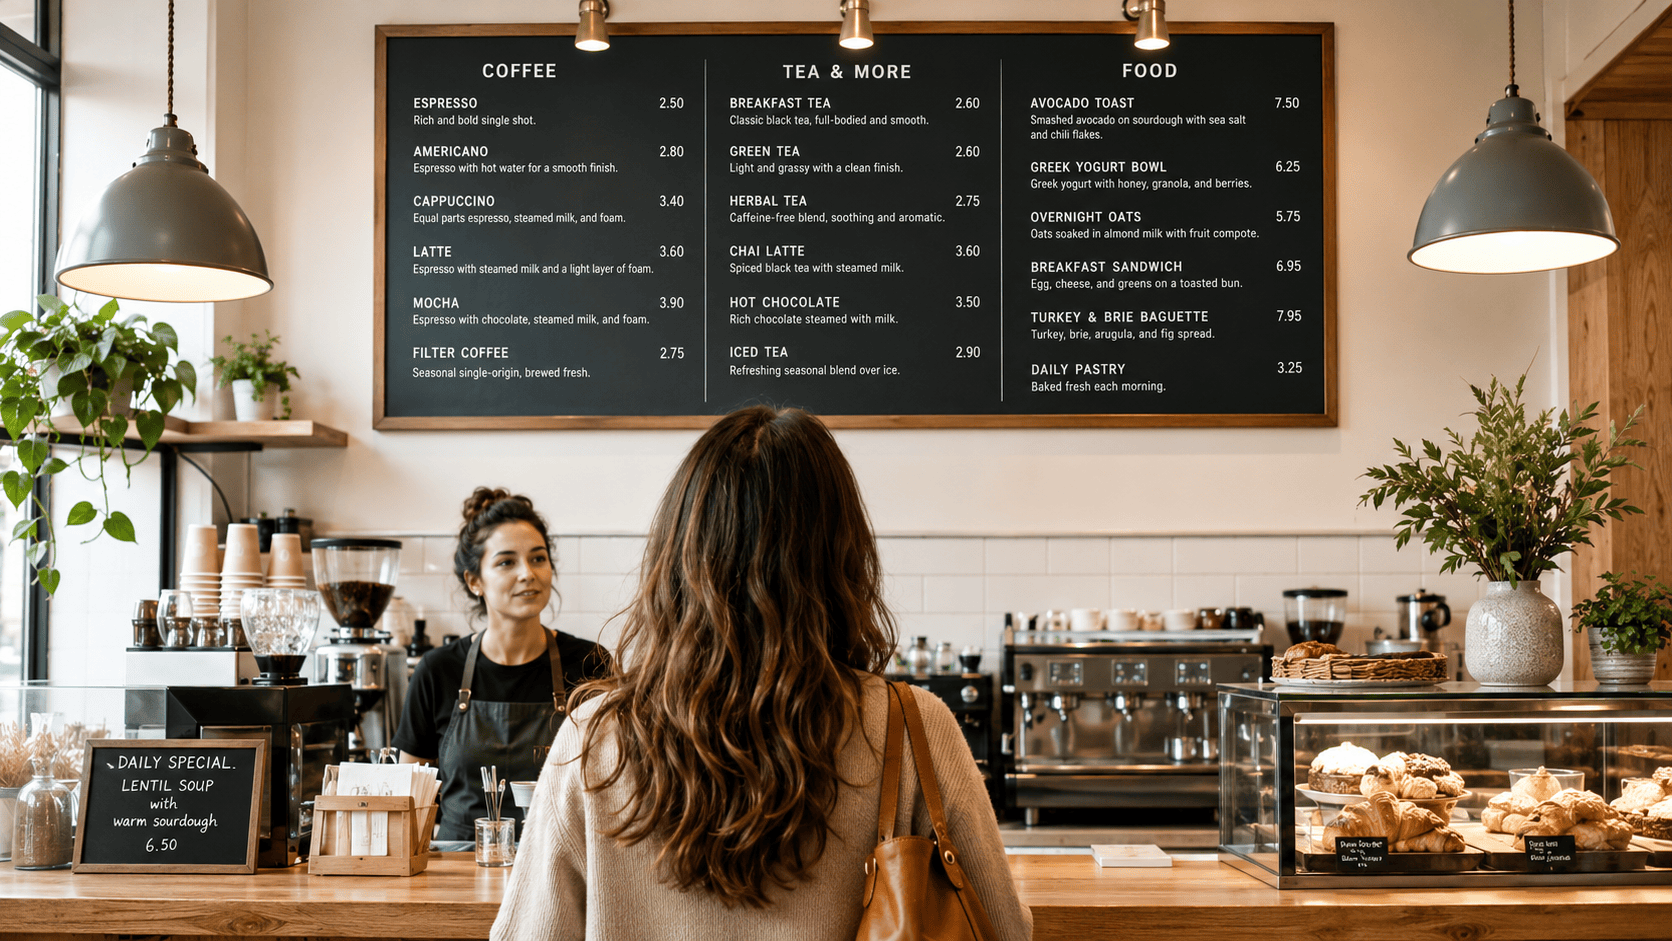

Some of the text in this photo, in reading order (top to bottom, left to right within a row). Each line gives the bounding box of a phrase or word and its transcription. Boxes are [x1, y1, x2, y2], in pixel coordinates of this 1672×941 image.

[482, 62, 557, 79] COFFEE
[782, 64, 911, 79] TEA & MORE
[1122, 62, 1178, 79] FOOD
[413, 97, 478, 109] ESPRESSO
[659, 96, 684, 109] 2.50
[729, 97, 832, 109] BREAKFAST TEA
[955, 96, 980, 109] 2.60
[1030, 97, 1135, 109] AVOCADO TOAST
[1274, 96, 1300, 109] 7.50
[413, 114, 537, 128] Rich and bold single shot.
[729, 114, 929, 127] Classic black tea, full-bodied and smooth.
[1030, 114, 1247, 128] Smashed avocado on sourdough with sea salt
[1030, 128, 1103, 140] and chili flakes.
[413, 145, 489, 157] AMERICANO
[659, 145, 685, 158] 2.80
[729, 145, 801, 157] GREEN TEA
[955, 145, 981, 158] 2.60
[1030, 161, 1167, 173] GREEK YOGURT BOWL
[1275, 160, 1301, 173] 6.25
[1030, 177, 1253, 192] Greek yogurt with honey, granola, and berries.
[413, 195, 495, 207] CAPPUCCINO
[659, 194, 685, 207] 3.40
[729, 194, 808, 207] HERBAL TEA
[955, 194, 981, 207] 2.75
[413, 212, 626, 226] Equal parts espresso, steamed milk, and foam.
[729, 211, 946, 225] Caffeine-free blend, soothing and aromatic.
[1030, 211, 1142, 223] OVERNIGHT OATS
[1275, 210, 1301, 223] 5.75
[1030, 227, 1260, 241] Oats soaked in almond milk with fruit compote.
[413, 245, 452, 258] LATTE
[659, 244, 685, 258] 3.60
[729, 244, 805, 257] CHAI LATTE
[955, 244, 981, 257] 3.60
[729, 262, 904, 275] Spiced black tea with steamed milk.
[1031, 260, 1182, 273] BREAKFAST SANDWICH
[1276, 259, 1302, 272] 6.95
[413, 296, 460, 309] MOCHA
[659, 296, 685, 309] 3.90
[729, 296, 840, 308] HOT CHOCOLATE
[955, 295, 981, 308] 3.50
[412, 313, 650, 327] Espresso with chocolate, steamed milk, and foam.
[729, 313, 899, 325] Rich chocolate steamed with milk.
[1030, 310, 1209, 323] TURKEY & BRIE BAGUETTE
[1276, 309, 1302, 322] 7.95
[1030, 327, 1215, 342] Turkey, brie, arugula, and fig spread.
[412, 346, 509, 359] FILTER COFFEE
[659, 346, 685, 360] 2.75
[729, 346, 789, 358] ICED TEA
[955, 345, 981, 359] 2.90
[412, 366, 591, 381] Seasonal single-origin, brewed fresh.
[729, 364, 901, 378] Refreshing seasonal blend over ice.
[1031, 363, 1126, 376] DAILY PASTRY
[1277, 361, 1303, 374] 3.25
[1031, 380, 1167, 394] Baked fresh each morning.
[117, 755, 236, 770] DAILY SPECIAL.
[121, 778, 215, 793] LENTIL SOUP
[150, 796, 178, 810] with
[113, 813, 218, 834] warm sourdough
[145, 837, 178, 853] 6.50
